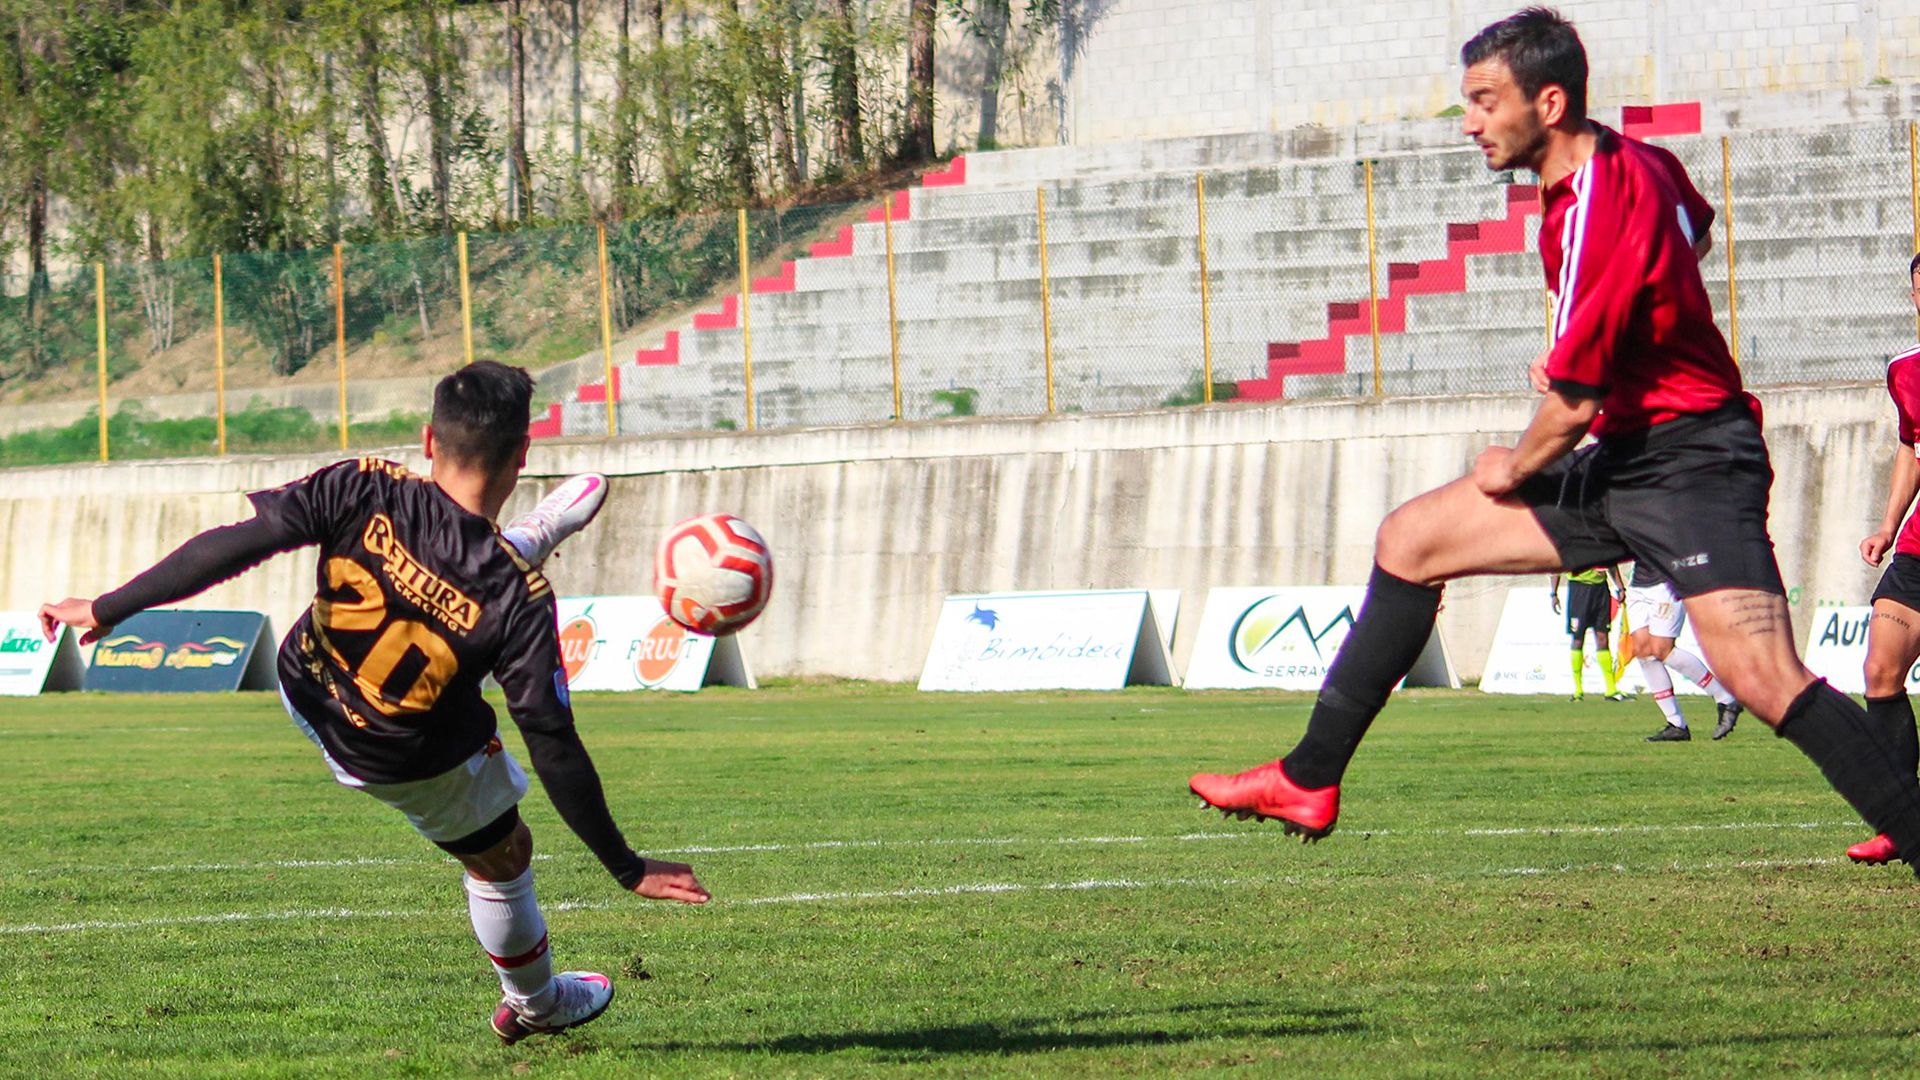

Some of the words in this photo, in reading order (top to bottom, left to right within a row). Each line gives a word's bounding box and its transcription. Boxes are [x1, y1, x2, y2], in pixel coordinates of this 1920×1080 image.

[1658, 602, 1671, 616] 17
[313, 556, 460, 716] 20
[978, 632, 1123, 662] Bimbidea
[1525, 671, 1546, 682] Costa
